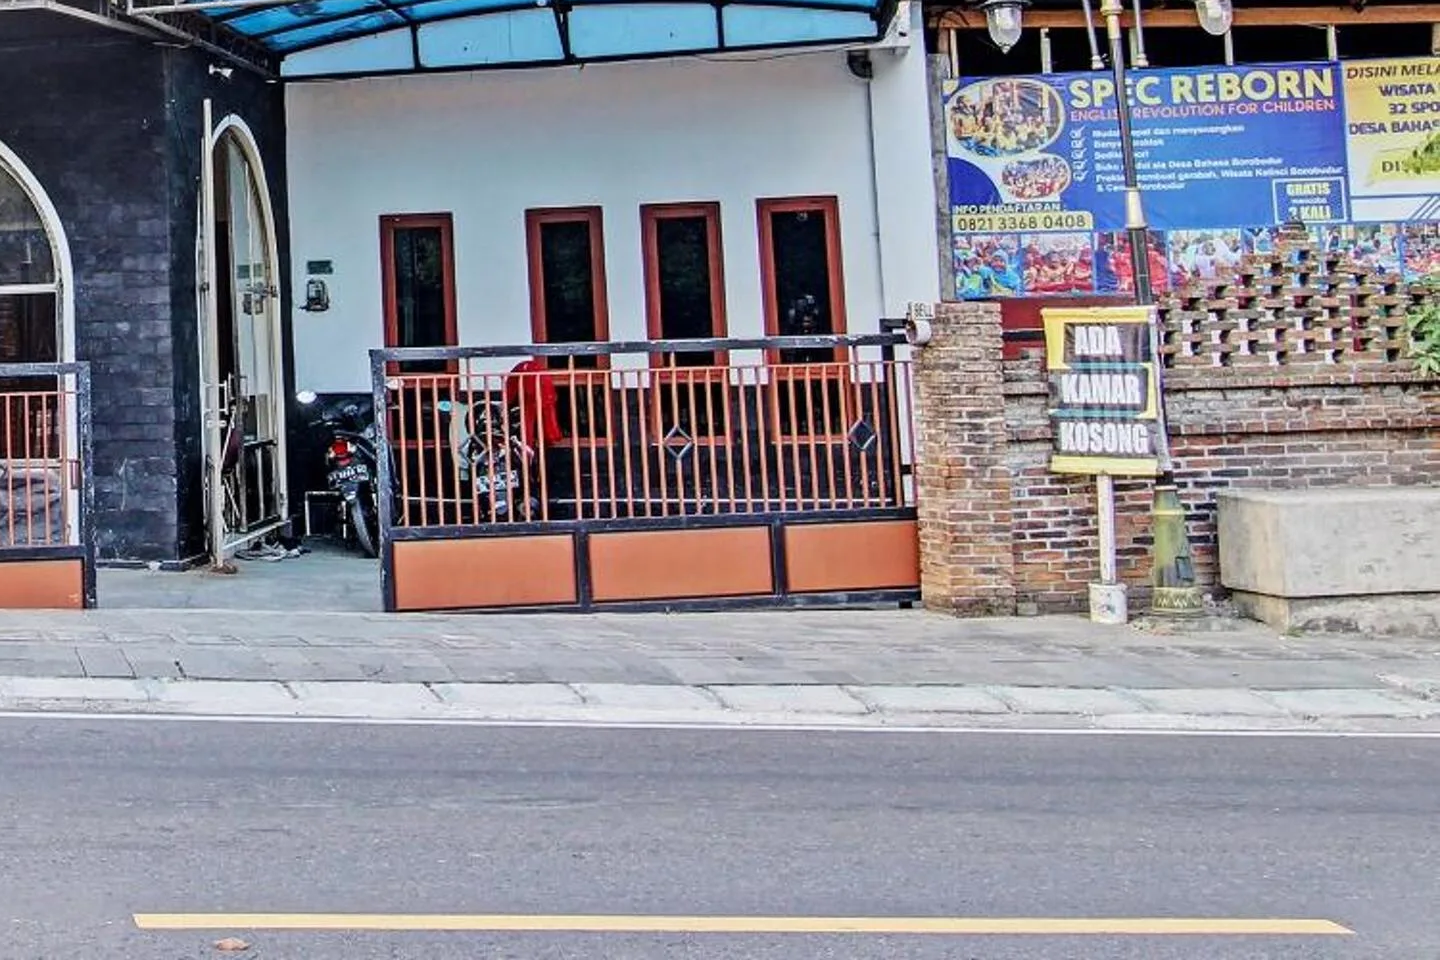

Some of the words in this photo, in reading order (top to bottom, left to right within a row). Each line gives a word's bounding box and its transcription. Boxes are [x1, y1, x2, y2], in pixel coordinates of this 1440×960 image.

[1347, 65, 1397, 79] DISINI
[1171, 68, 1334, 104] REBORN
[1379, 83, 1435, 96] WISATA
[1070, 109, 1119, 122] ENGLIS
[1133, 104, 1225, 119] REVOLUTION
[1228, 103, 1258, 115] FOR
[1263, 100, 1335, 113] CHILDREN
[1388, 102, 1407, 114] 32
[1349, 122, 1387, 135] DESA
[957, 218, 993, 231] 0821
[998, 215, 1037, 230] 3368
[1043, 214, 1086, 228] 0408
[1074, 325, 1123, 356] ADA
[1061, 374, 1141, 405] KAMAR
[1060, 422, 1149, 453] KOSONG
